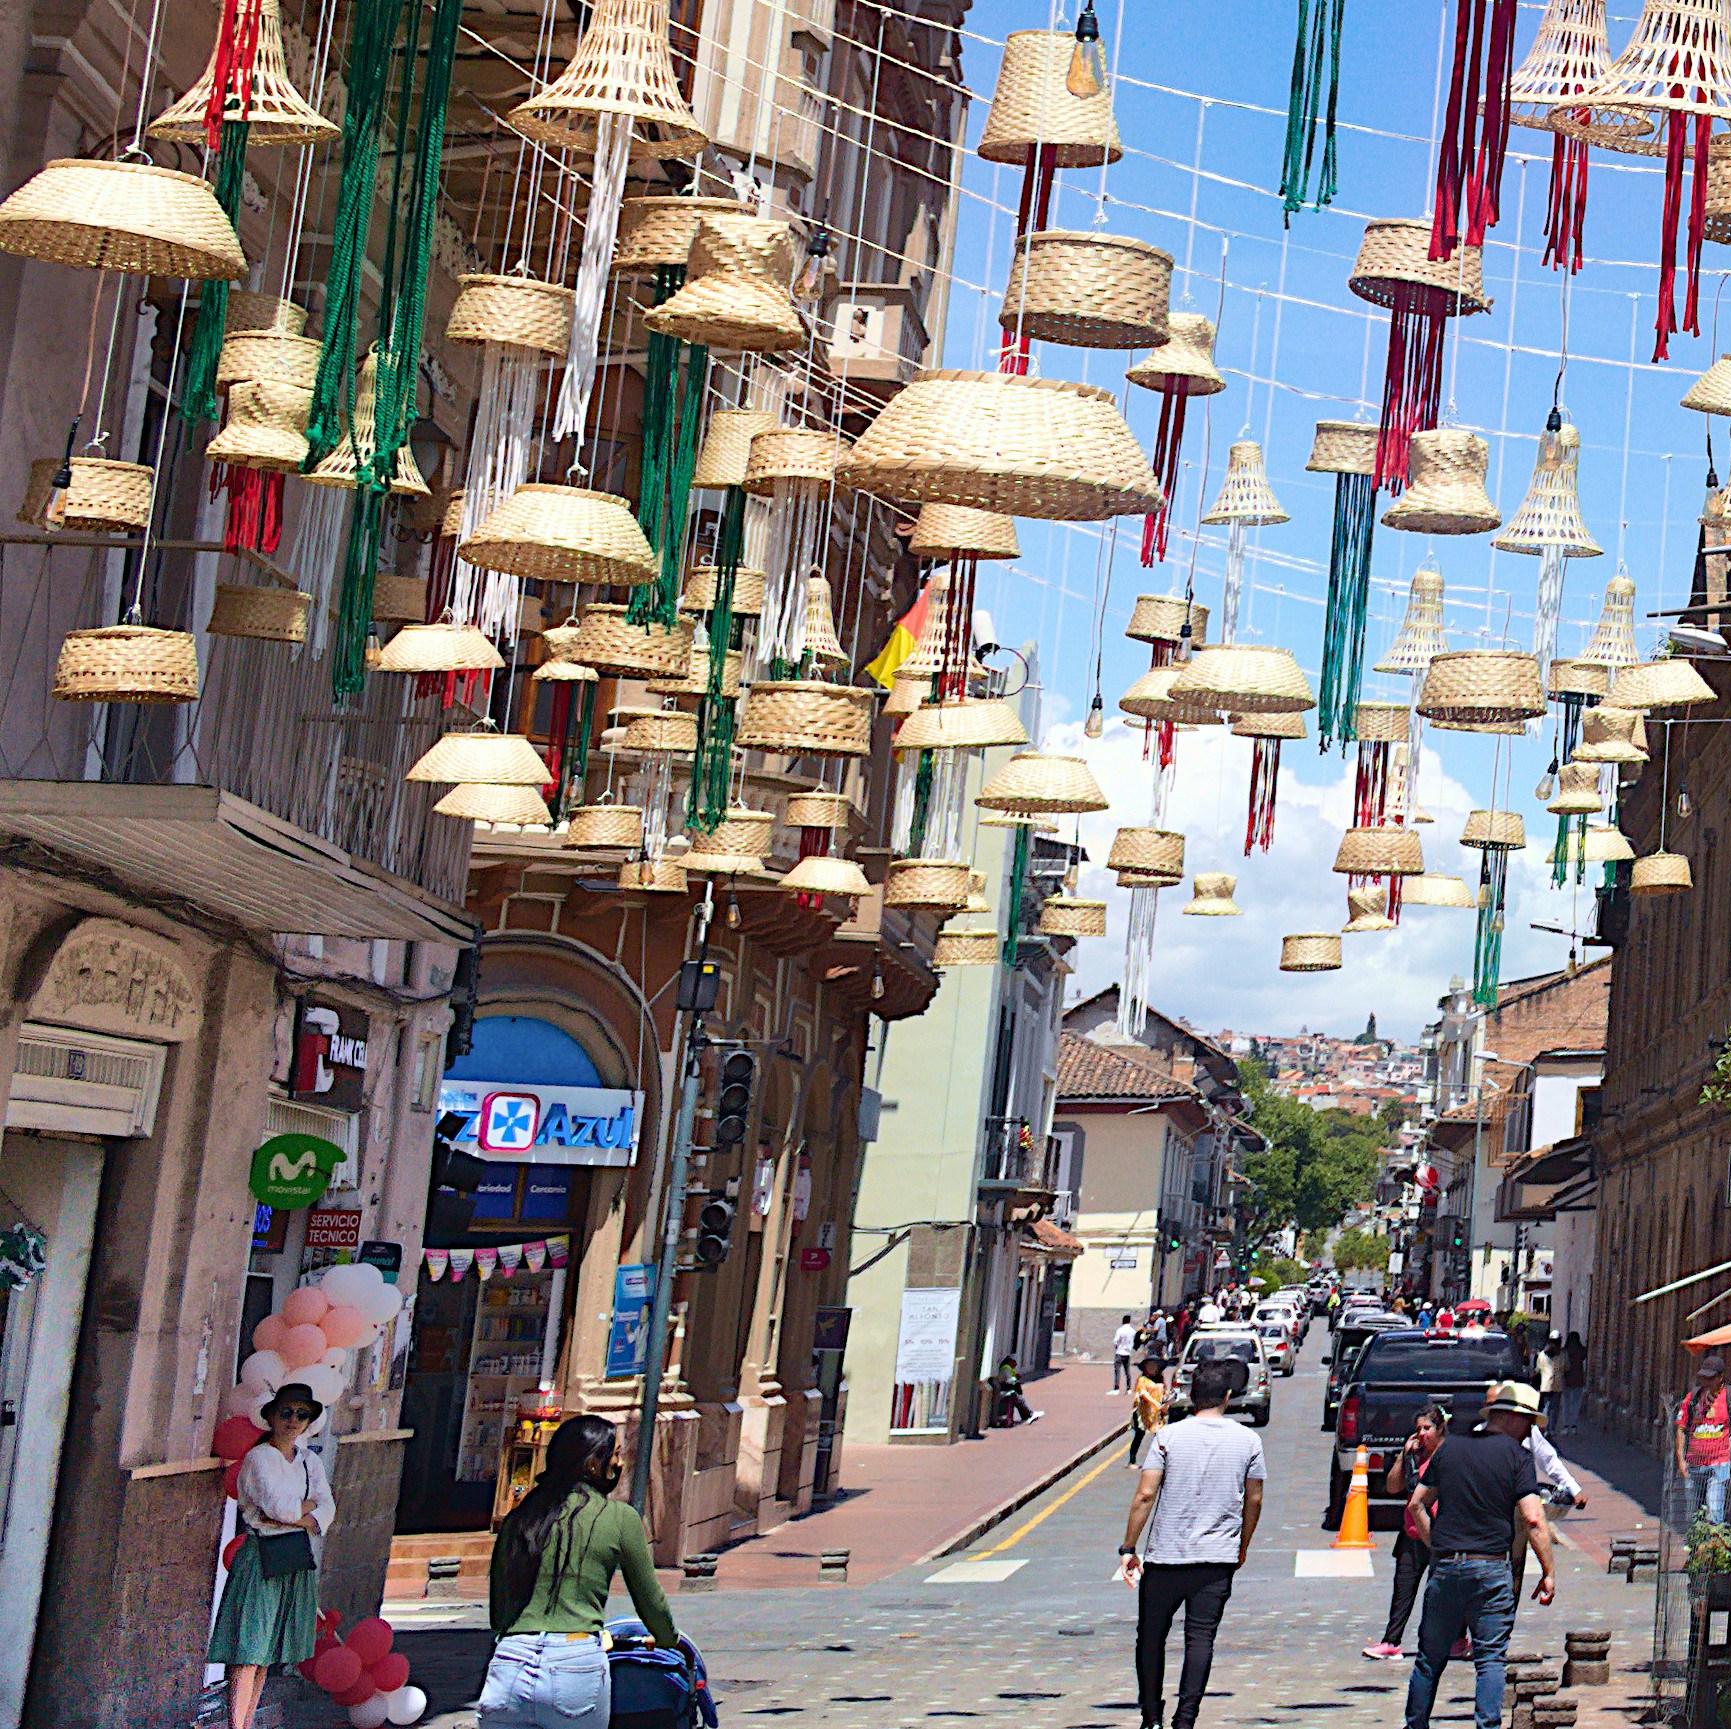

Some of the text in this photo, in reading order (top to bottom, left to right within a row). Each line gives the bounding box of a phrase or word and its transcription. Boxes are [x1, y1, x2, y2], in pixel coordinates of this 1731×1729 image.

[535, 1103, 634, 1149] Azul
[310, 1214, 359, 1228] SERVICIO
[309, 1229, 358, 1243] TECNICO
